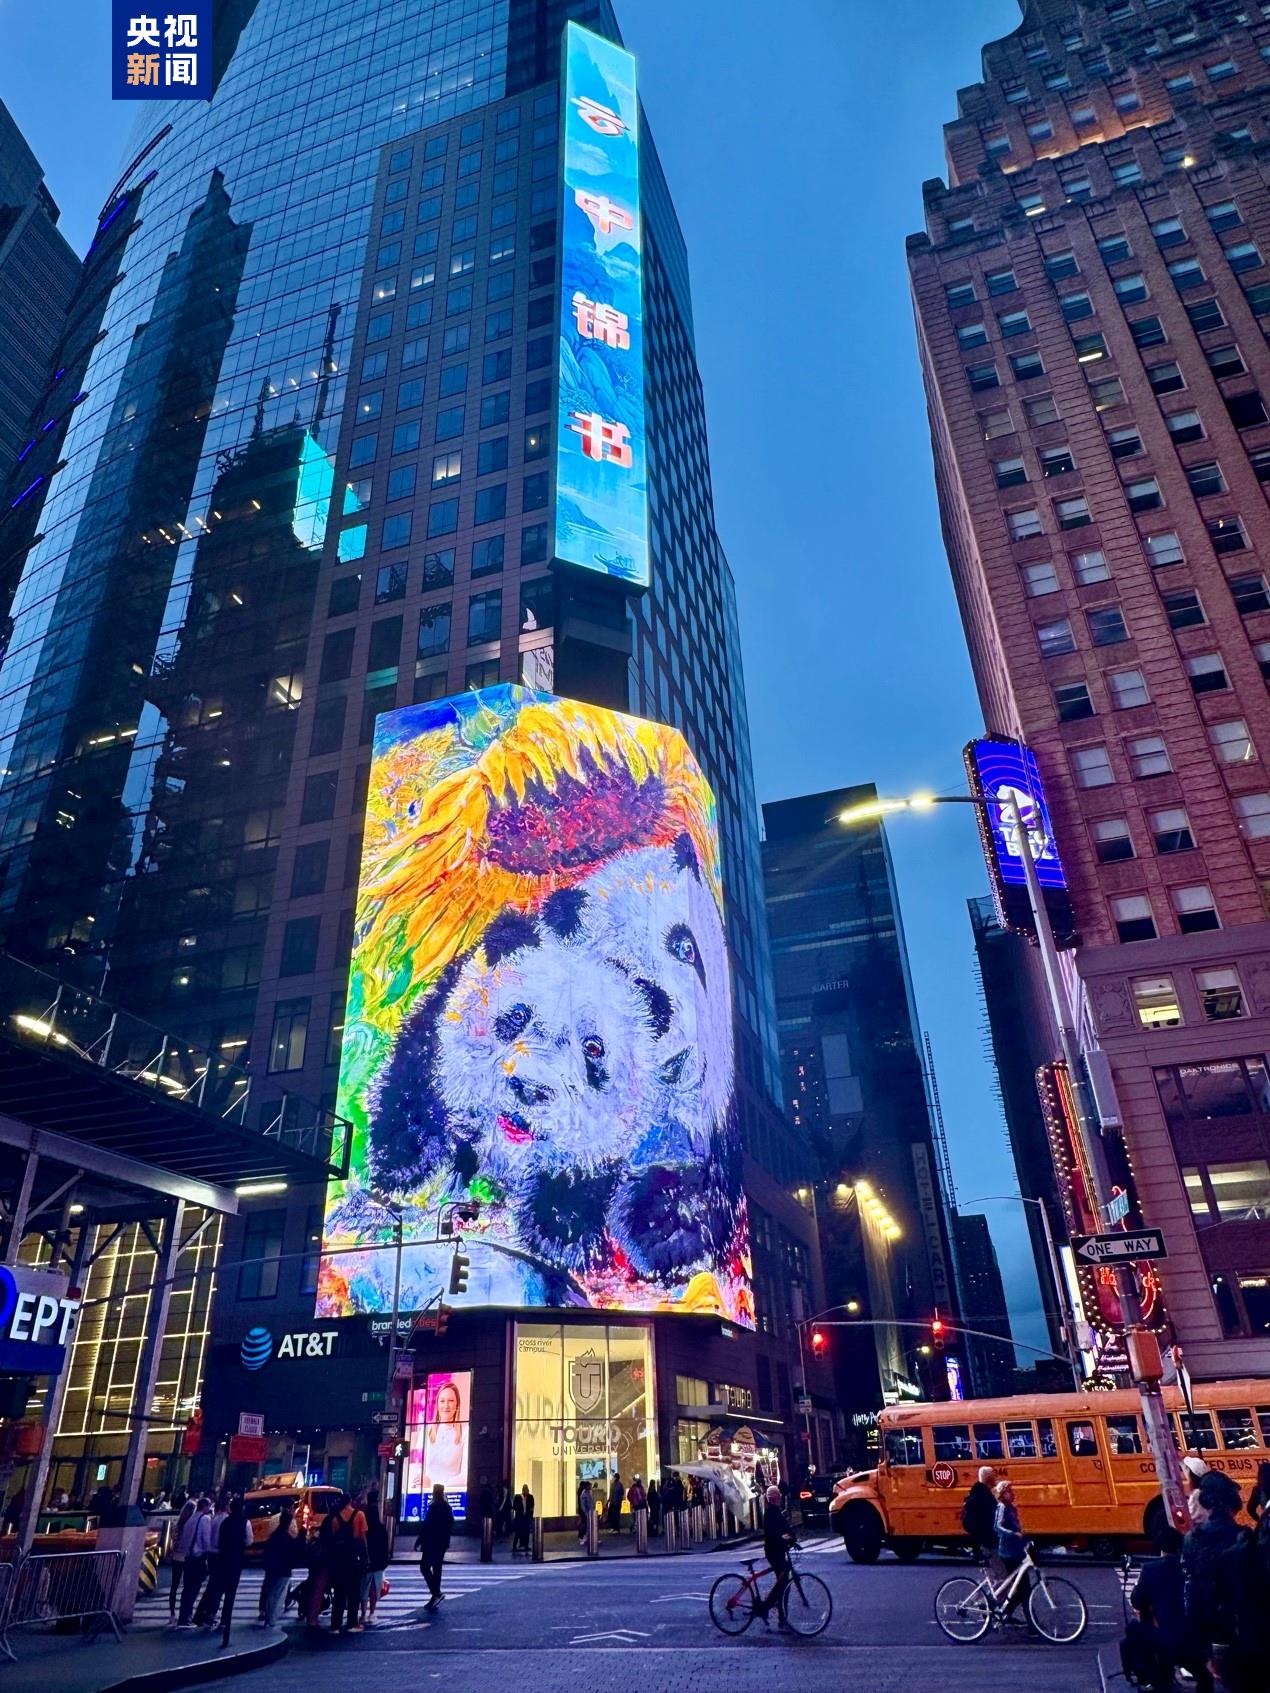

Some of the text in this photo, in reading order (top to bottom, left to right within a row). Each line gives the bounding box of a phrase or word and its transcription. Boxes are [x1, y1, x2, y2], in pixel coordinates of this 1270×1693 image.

[567, 95, 633, 469] 云中锦书
[1006, 841, 1055, 860] BLL
[1087, 1238, 1152, 1256] ONE WAY
[277, 1331, 339, 1359] AT&T
[550, 1423, 620, 1443] TOURO
[552, 1445, 618, 1456] UNIVERSITY
[1228, 1458, 1253, 1471] BUS
[935, 1470, 951, 1480] STOP
